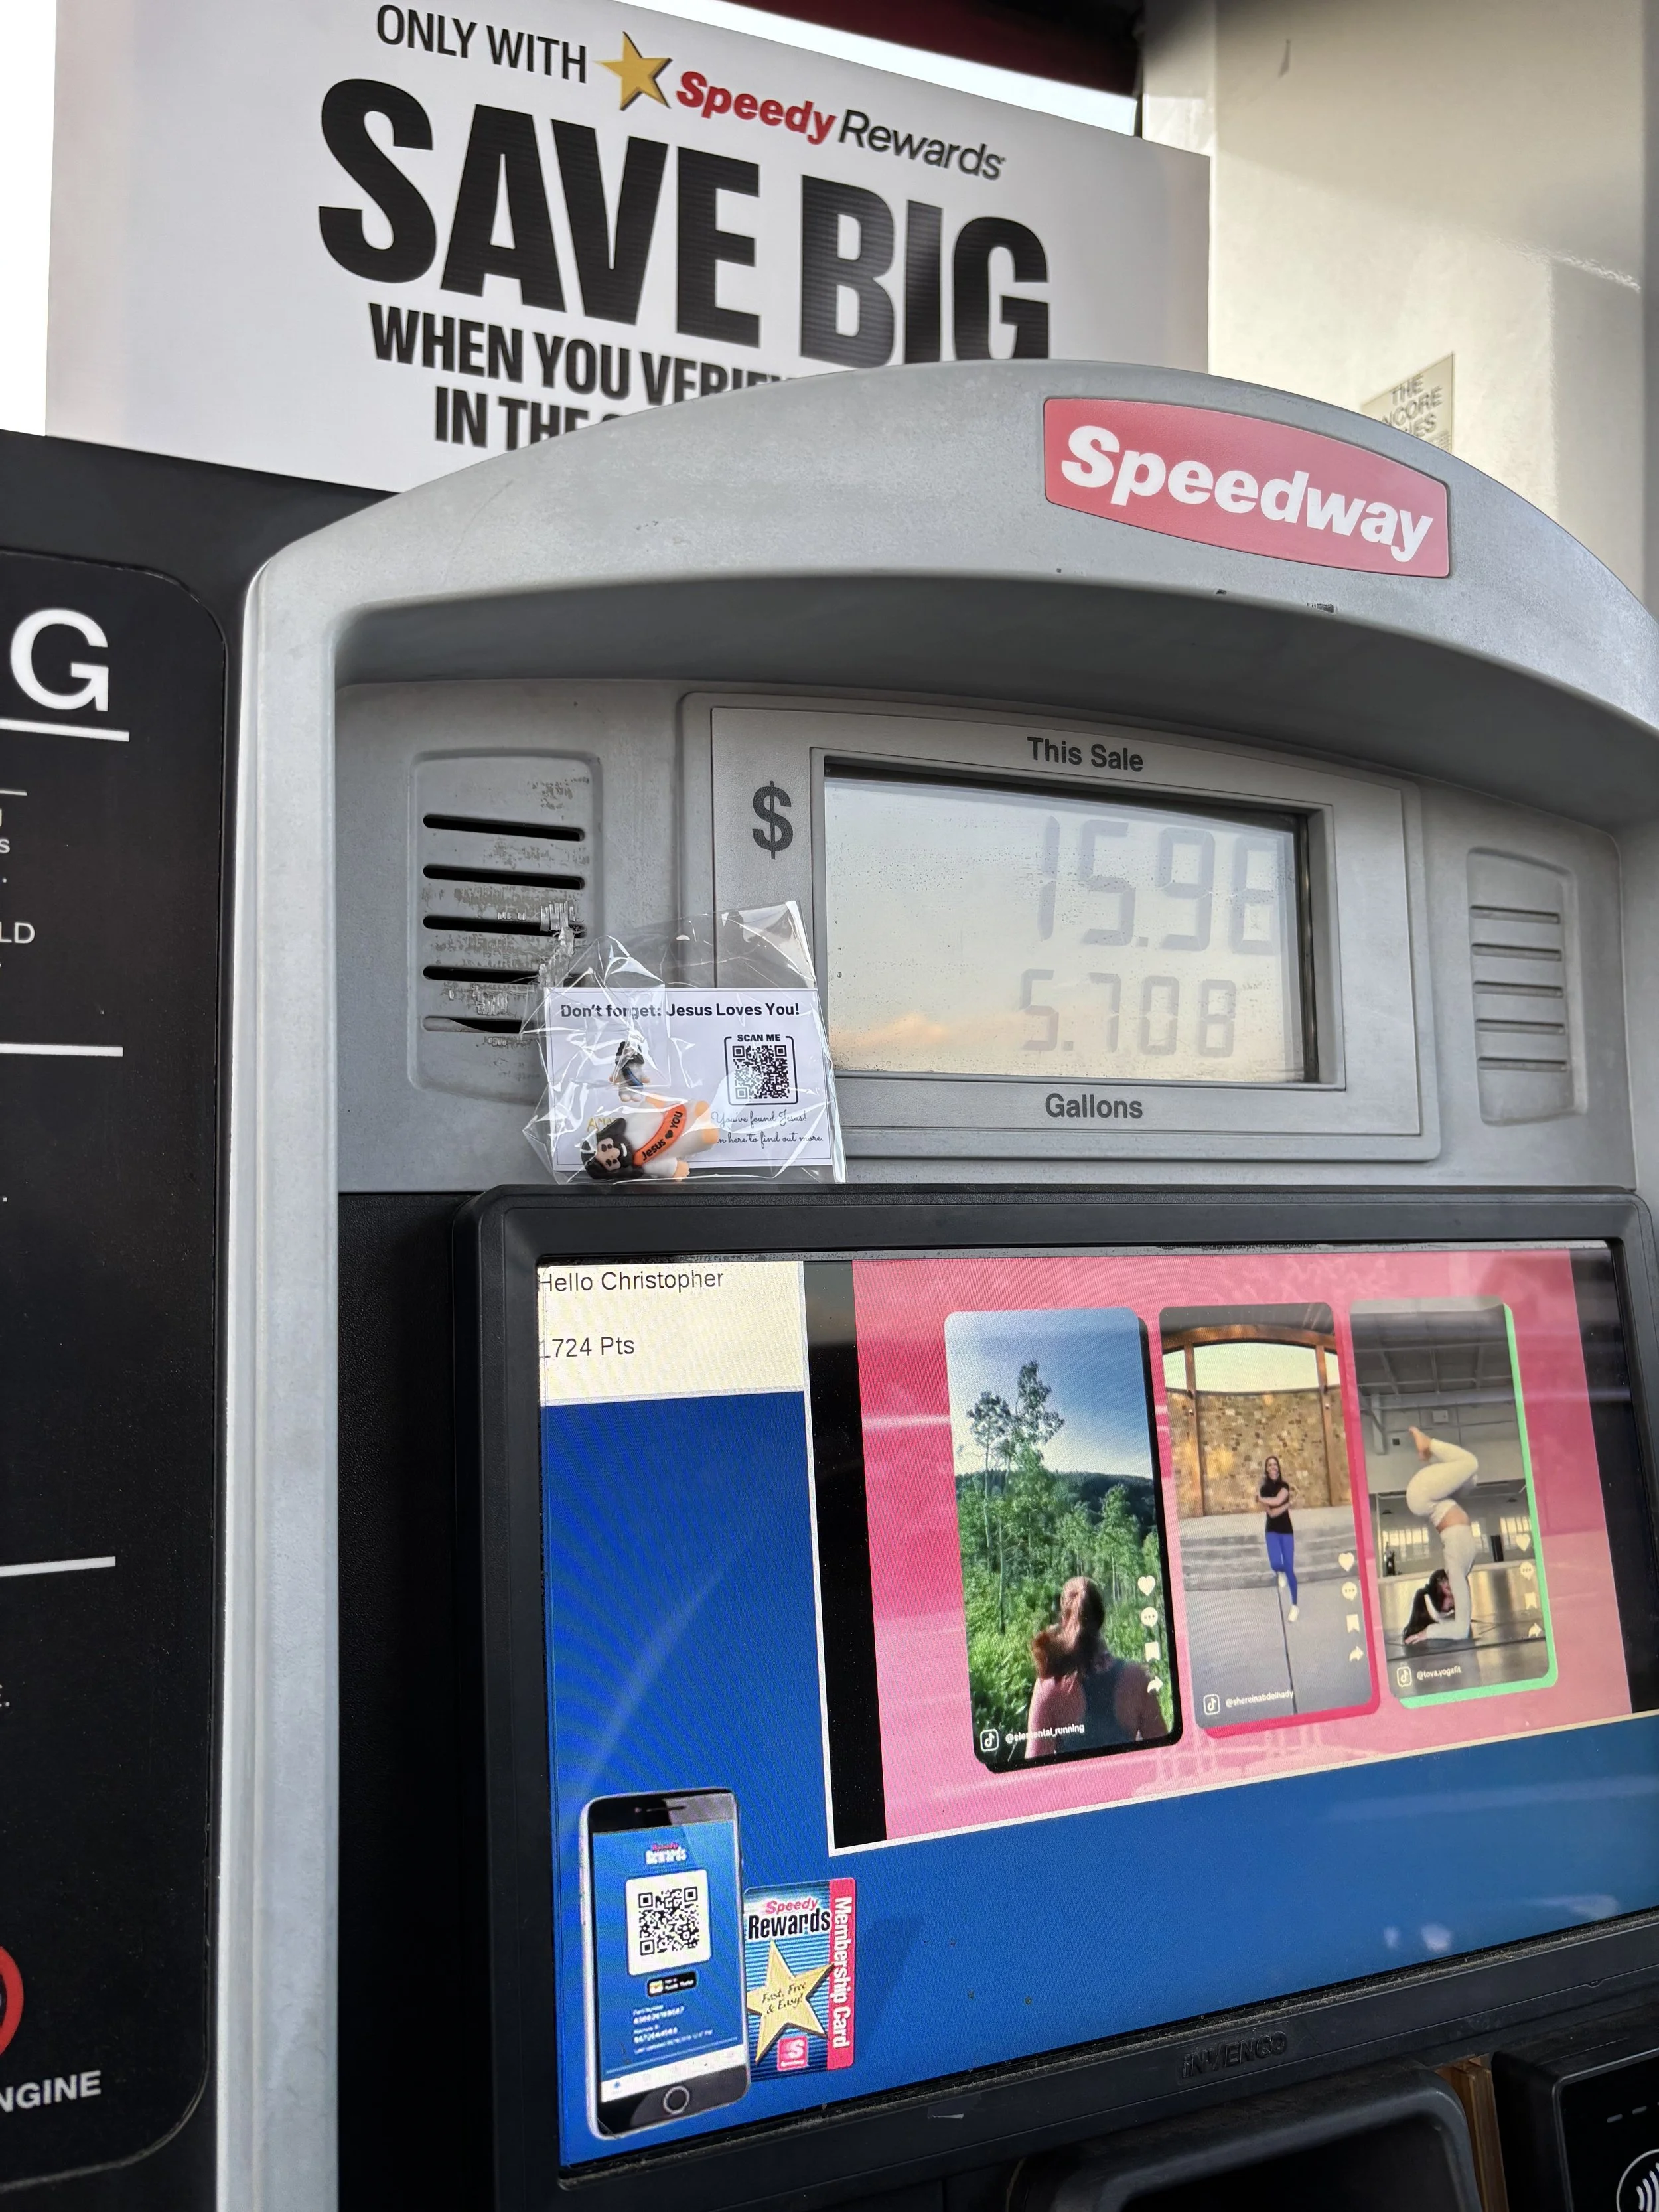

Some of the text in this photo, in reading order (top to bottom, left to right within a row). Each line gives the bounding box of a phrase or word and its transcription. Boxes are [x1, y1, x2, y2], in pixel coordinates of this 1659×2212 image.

[376, 4, 587, 83] ONLY WITH
[676, 71, 1002, 181] Speedy Rewards
[319, 78, 1050, 368] SAVE BIG
[368, 303, 790, 406] WHEN YOU VER
[1392, 373, 1423, 406] THE
[435, 386, 488, 448] IN
[1062, 425, 1433, 563] Speedway
[1027, 737, 1143, 772] This Sale
[752, 781, 794, 859] $
[561, 1003, 800, 1020] Don't forget: Jesus Loves You!
[1019, 968, 1236, 1058] 5.708
[670, 1111, 684, 1129] YOU
[711, 1109, 807, 1128] You've found Jesus!
[1045, 1093, 1143, 1120] Gallons
[642, 1138, 666, 1161] Jesus
[728, 1132, 747, 1143] here
[747, 1133, 758, 1143] to
[760, 1131, 780, 1149] find
[782, 1132, 798, 1142] out
[601, 1270, 724, 1293] Christopher
[601, 1336, 635, 1356] Pts
[1005, 1724, 1085, 1744] @elemental_running
[765, 1898, 818, 1915] Speedy
[748, 1908, 831, 1939] Rewards
[833, 1896, 853, 2049] Membership Card
